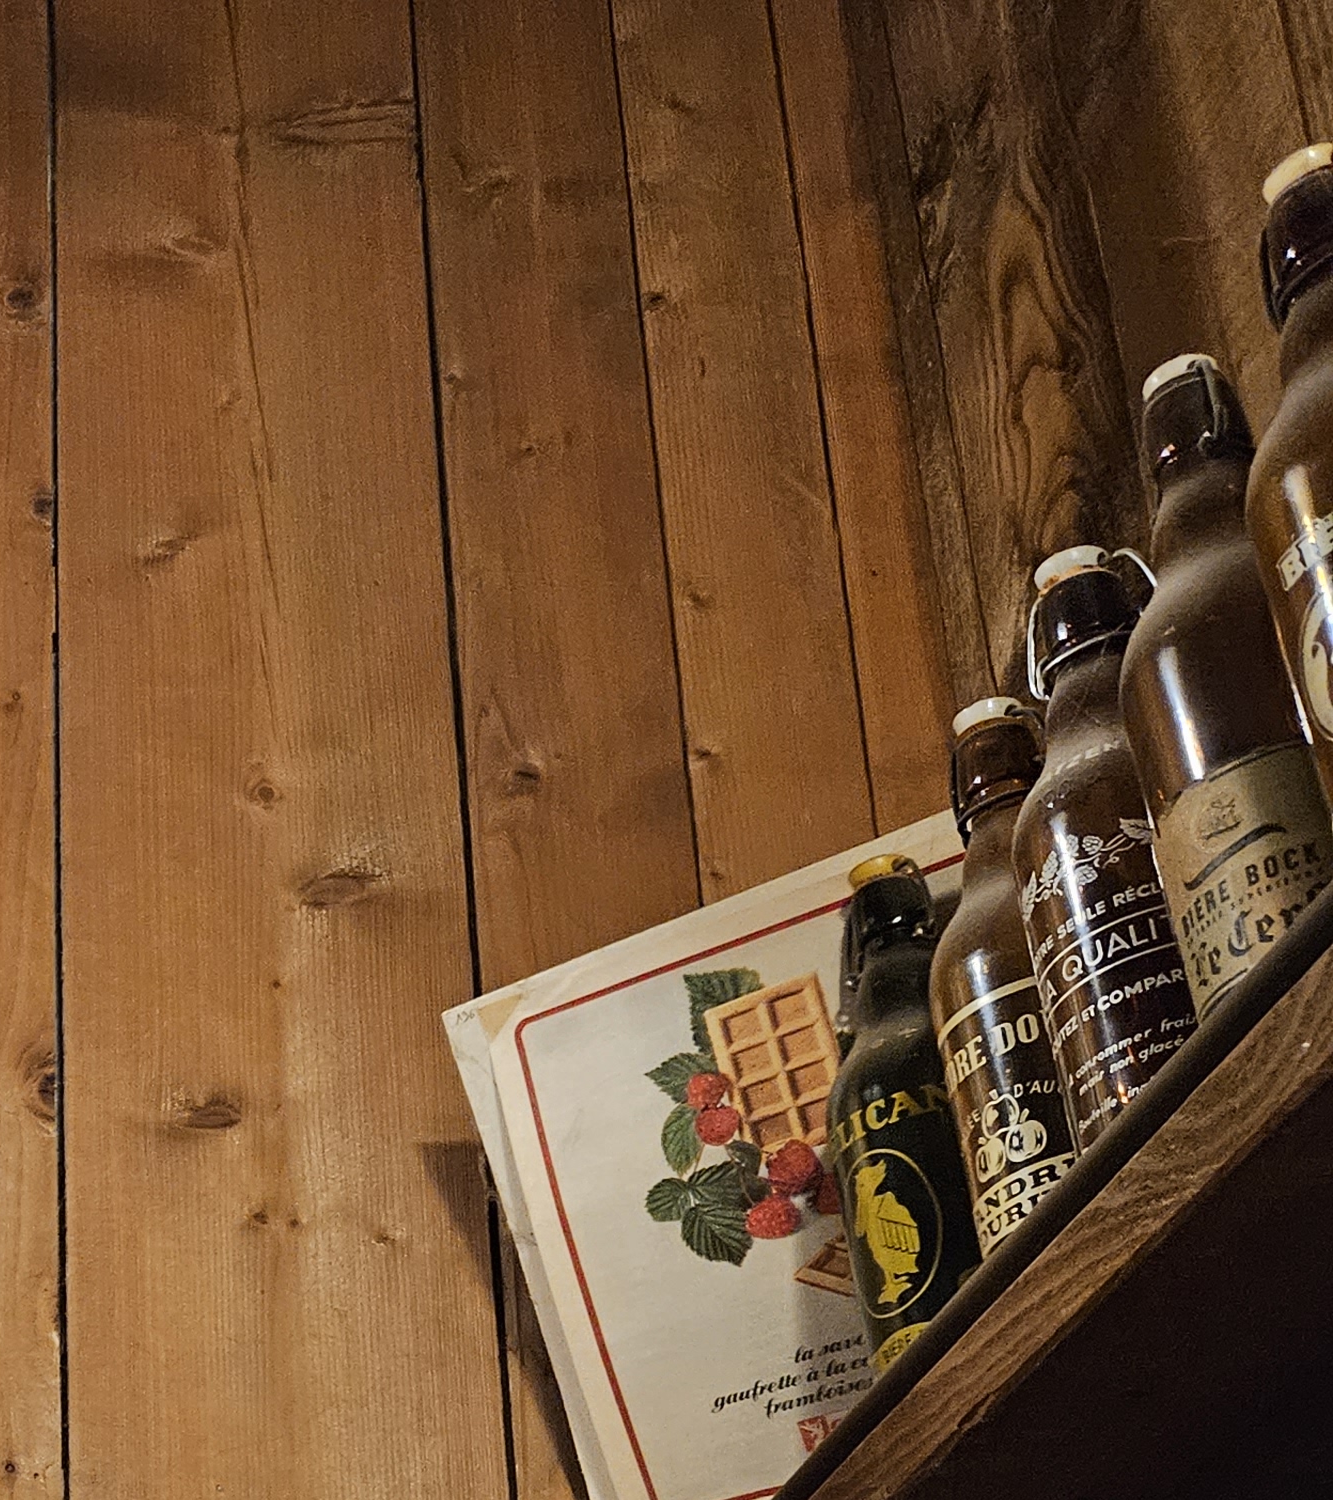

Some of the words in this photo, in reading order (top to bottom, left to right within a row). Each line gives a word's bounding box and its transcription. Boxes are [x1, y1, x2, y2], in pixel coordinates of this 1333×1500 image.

[1245, 843, 1320, 886] BOCK
[1081, 1005, 1095, 1022] ET
[945, 1035, 986, 1098] DRE
[989, 1014, 1043, 1057] DO
[1110, 1056, 1134, 1074] non
[1014, 1079, 1059, 1098] D'AU
[794, 1347, 813, 1364] la
[711, 1375, 798, 1413] gaufrette
[806, 1367, 818, 1383] à
[826, 1360, 847, 1378] la
